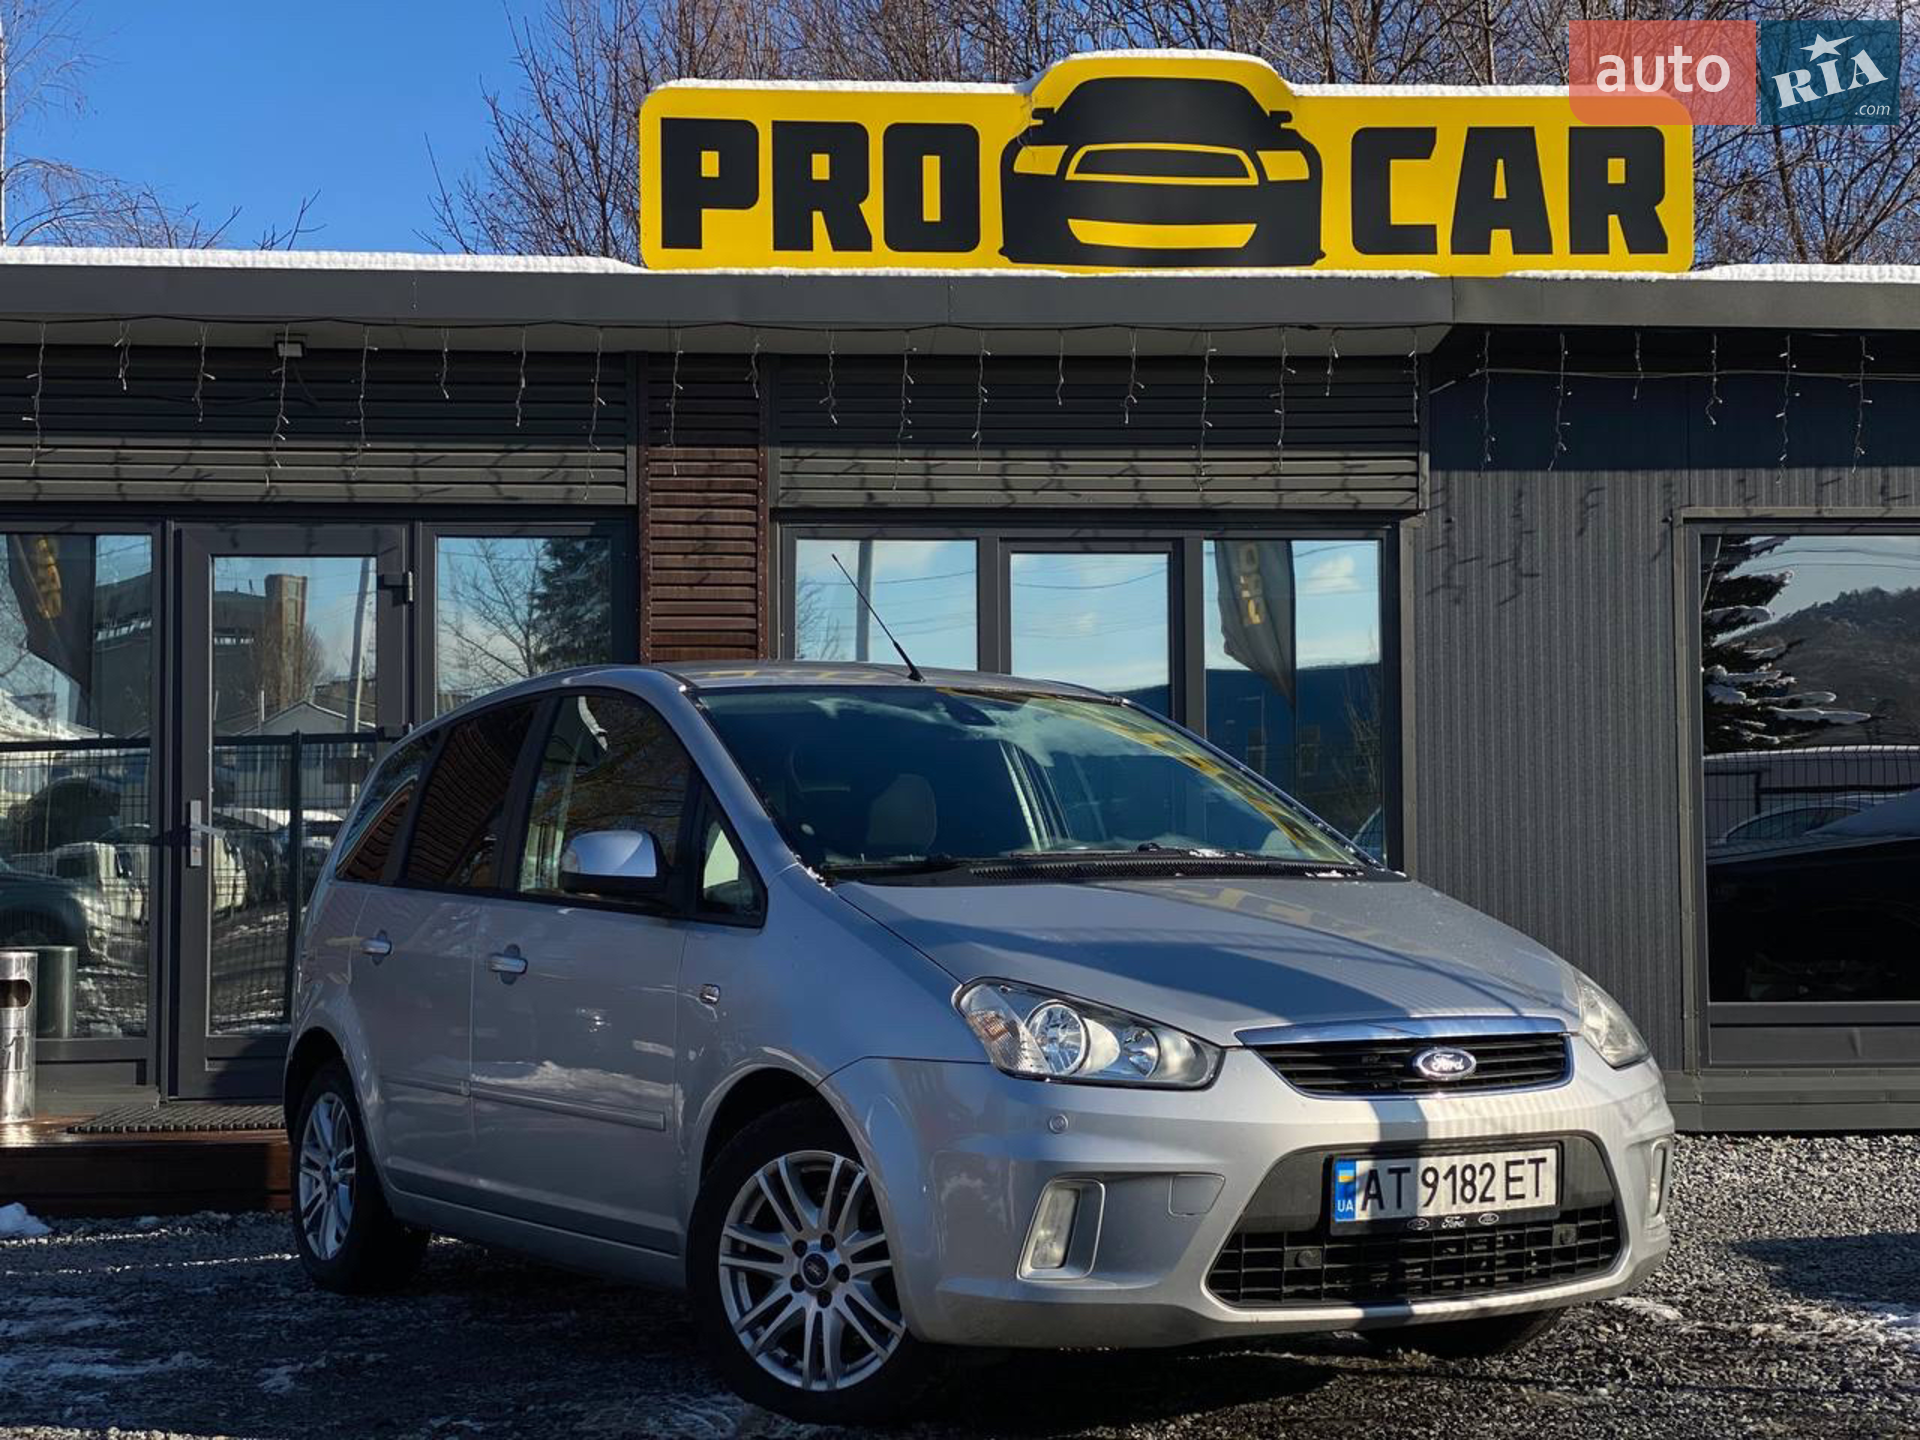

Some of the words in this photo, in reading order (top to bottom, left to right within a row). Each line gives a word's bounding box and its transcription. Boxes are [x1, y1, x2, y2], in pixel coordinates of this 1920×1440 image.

[660, 117, 981, 253] PRO
[1351, 126, 1669, 255] CAR
[1431, 1053, 1465, 1072] Ford
[1361, 1166, 1411, 1211] AT
[1421, 1162, 1496, 1208] 9182
[1505, 1156, 1547, 1202] ET
[1337, 1199, 1355, 1213] UA
